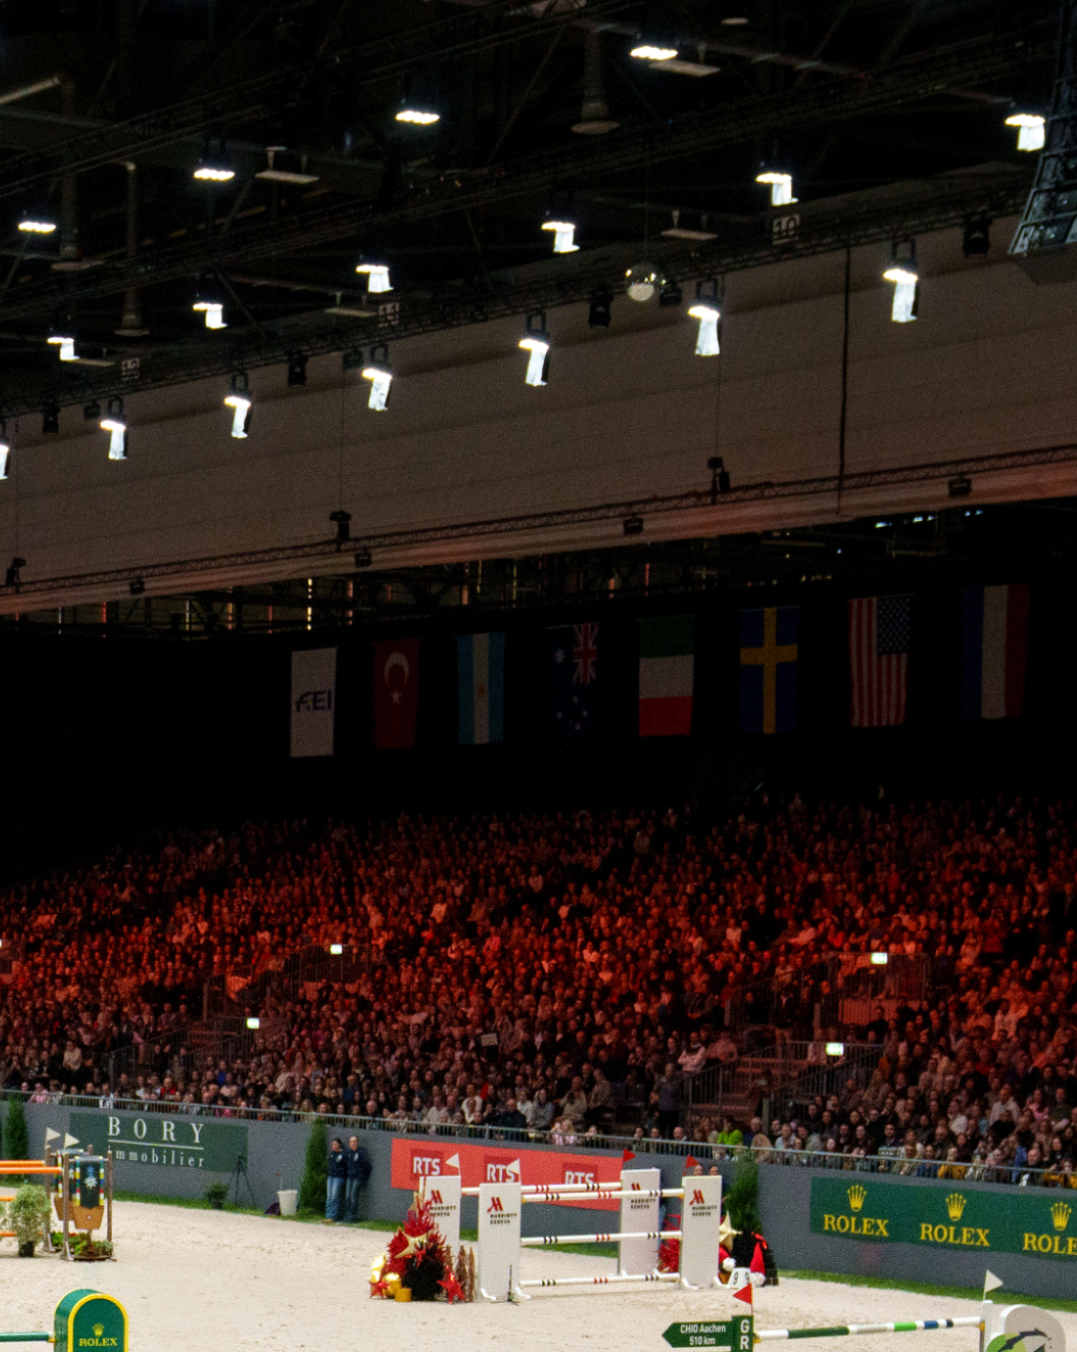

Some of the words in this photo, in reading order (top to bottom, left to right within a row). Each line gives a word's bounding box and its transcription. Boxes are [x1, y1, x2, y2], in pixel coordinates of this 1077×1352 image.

[108, 1116, 204, 1143] BORY
[413, 1157, 440, 1175] RTS
[487, 1163, 515, 1182] RTS
[823, 1214, 889, 1237] ROLEX
[920, 1223, 990, 1247] ROLEX
[680, 1324, 699, 1334] CHIO
[699, 1323, 726, 1333] Aachen
[79, 1338, 117, 1346] ROLEX
[689, 1336, 703, 1345] 510
[704, 1336, 716, 1344] km
